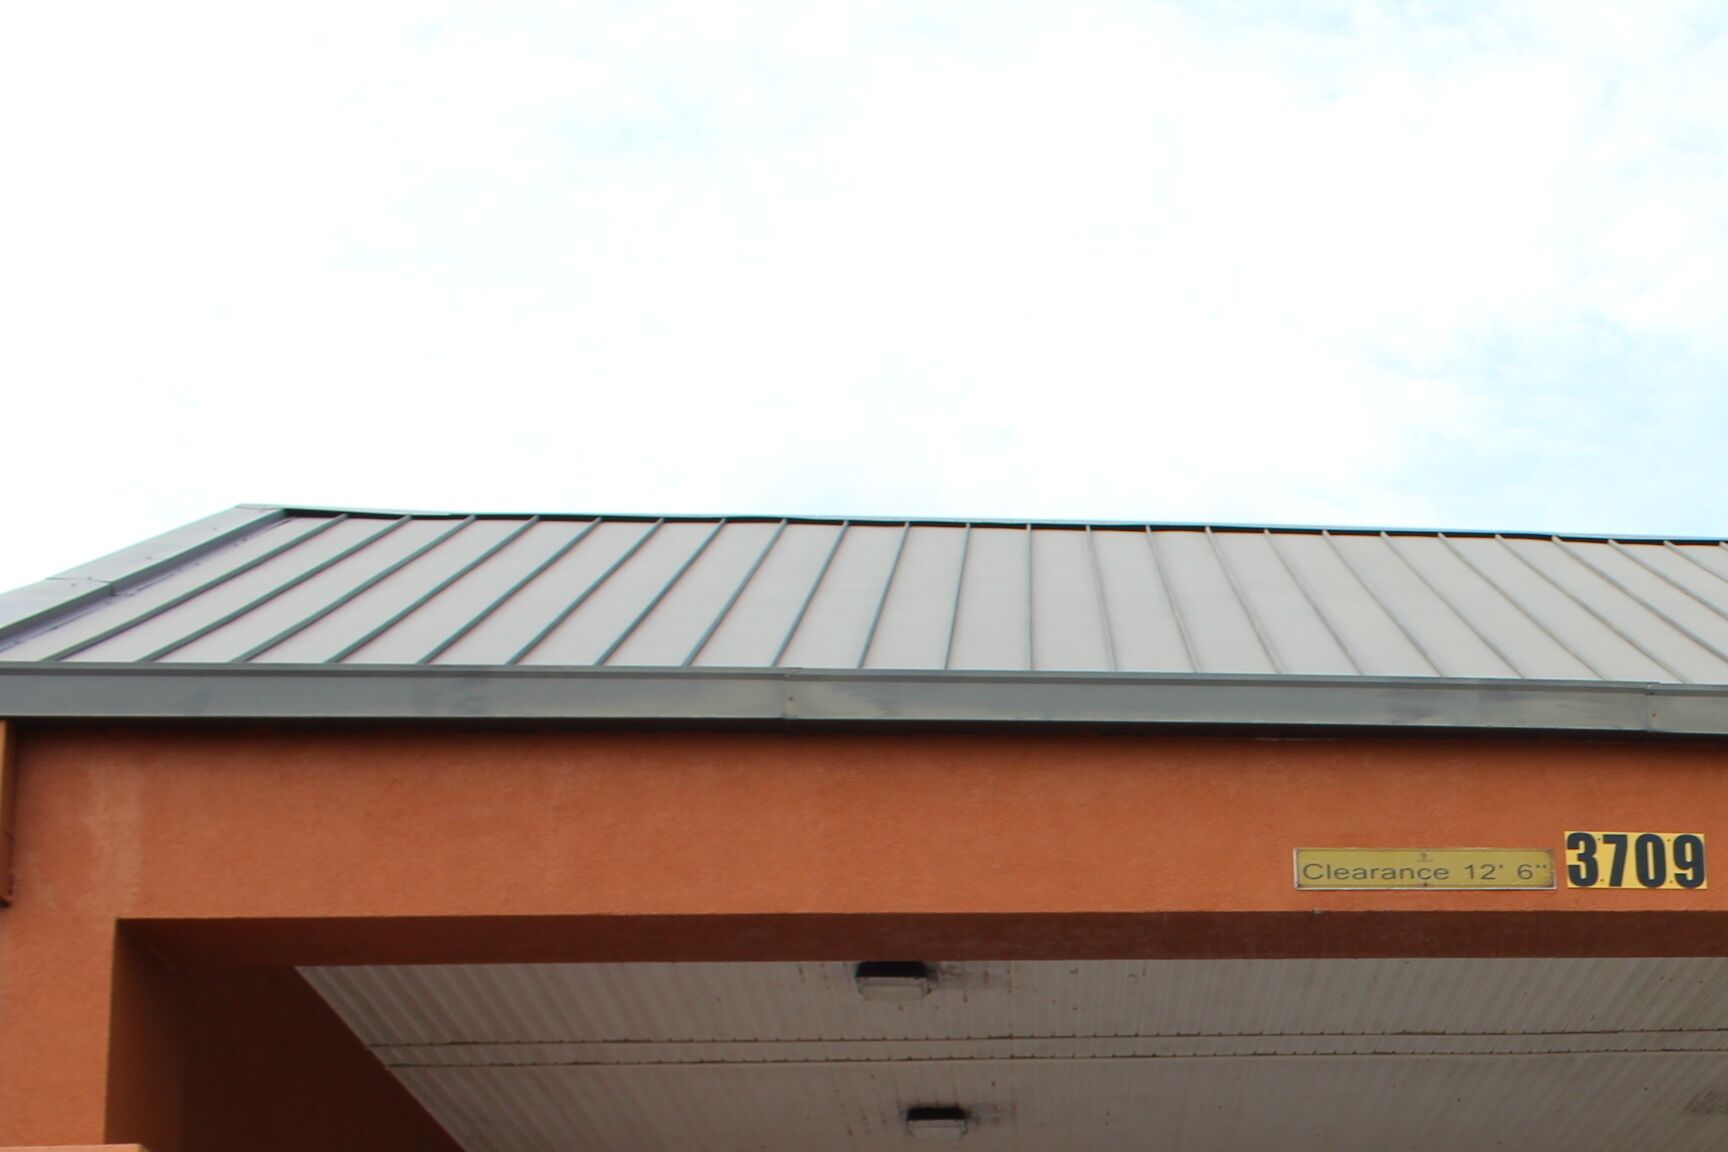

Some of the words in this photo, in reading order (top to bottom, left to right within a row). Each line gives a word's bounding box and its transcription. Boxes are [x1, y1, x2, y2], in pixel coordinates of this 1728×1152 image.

[1303, 863, 1449, 880] Clearance
[1464, 863, 1503, 880] 12'
[1567, 832, 1705, 888] 3709
